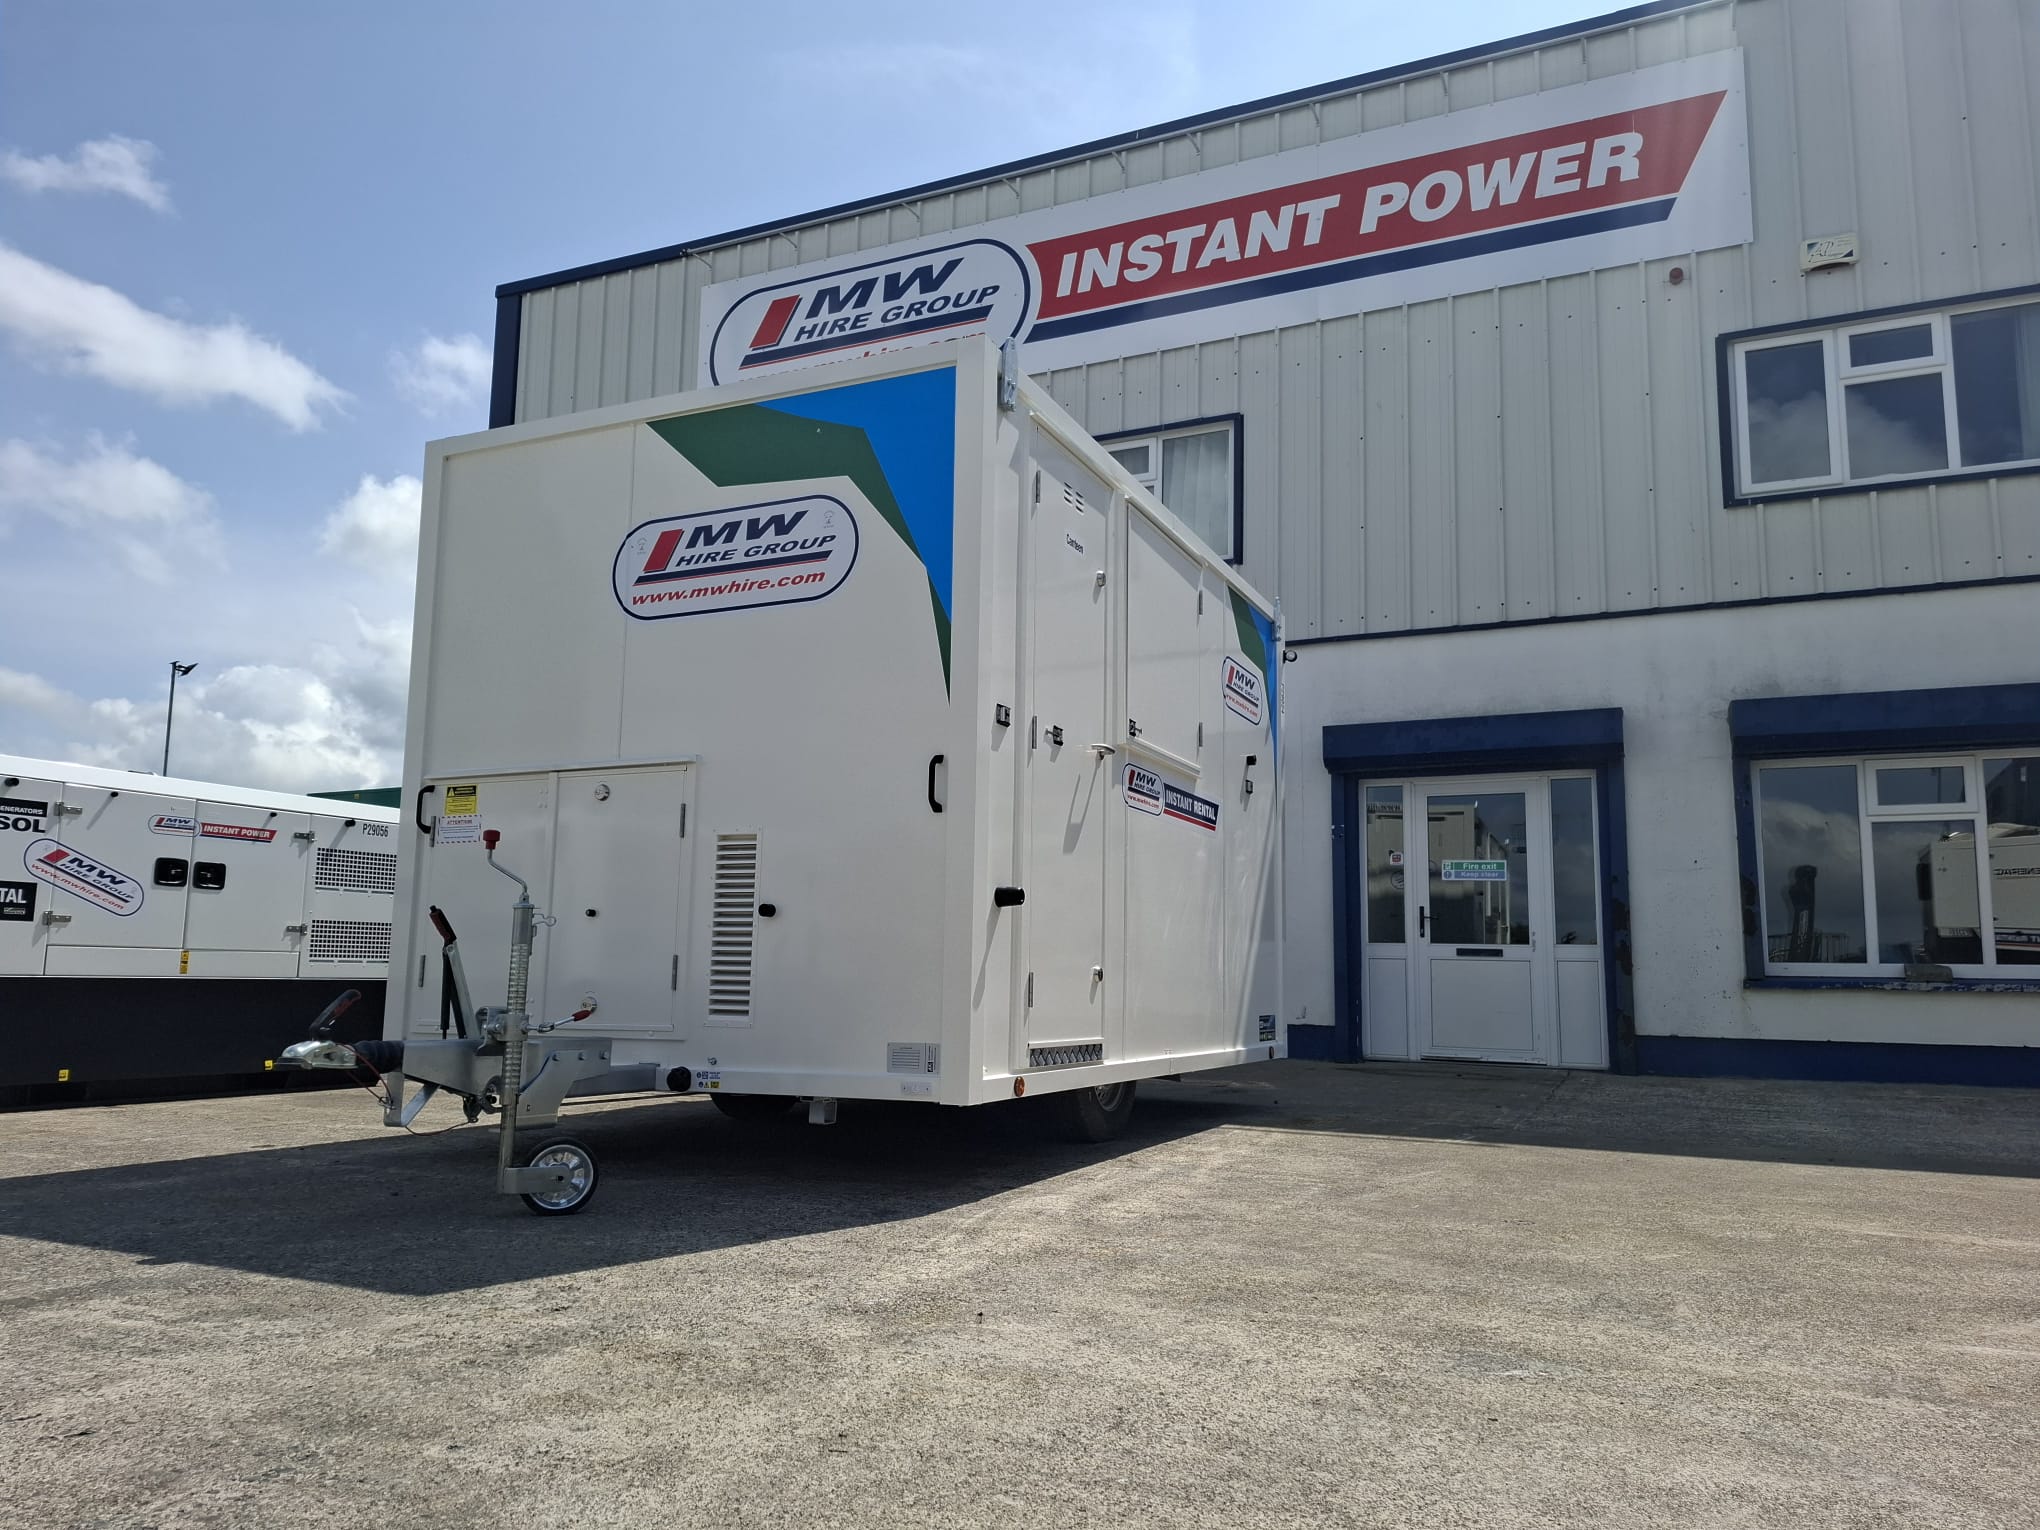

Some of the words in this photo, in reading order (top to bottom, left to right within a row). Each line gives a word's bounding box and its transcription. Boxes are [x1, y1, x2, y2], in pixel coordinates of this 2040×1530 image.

[1055, 193, 1341, 298] INSTANT
[1358, 131, 1645, 236] POWER
[804, 257, 965, 320] MW
[793, 310, 872, 343] HIRE
[879, 284, 1001, 326] GROUP
[684, 509, 810, 550] MW
[675, 549, 738, 568] HIRE
[743, 534, 837, 558] GROUP
[632, 571, 826, 606] www.mwhire.com
[1235, 669, 1255, 691] MW
[1135, 771, 1157, 787] MW
[0, 805, 44, 815] ENERATORS
[1165, 789, 1193, 811] INSTANT
[1193, 801, 1216, 820] RENTAL
[165, 817, 191, 825] MW
[203, 824, 240, 835] INSTANT
[241, 828, 271, 838] POWER
[362, 823, 389, 838] P29056
[59, 863, 91, 879] HIRE
[92, 879, 135, 899] GROUP
[67, 856, 127, 885] MW
[1462, 862, 1480, 870] Fire
[1481, 862, 1497, 870] exit
[0, 887, 28, 904] TAL
[31, 863, 125, 910] www.mwhire.com
